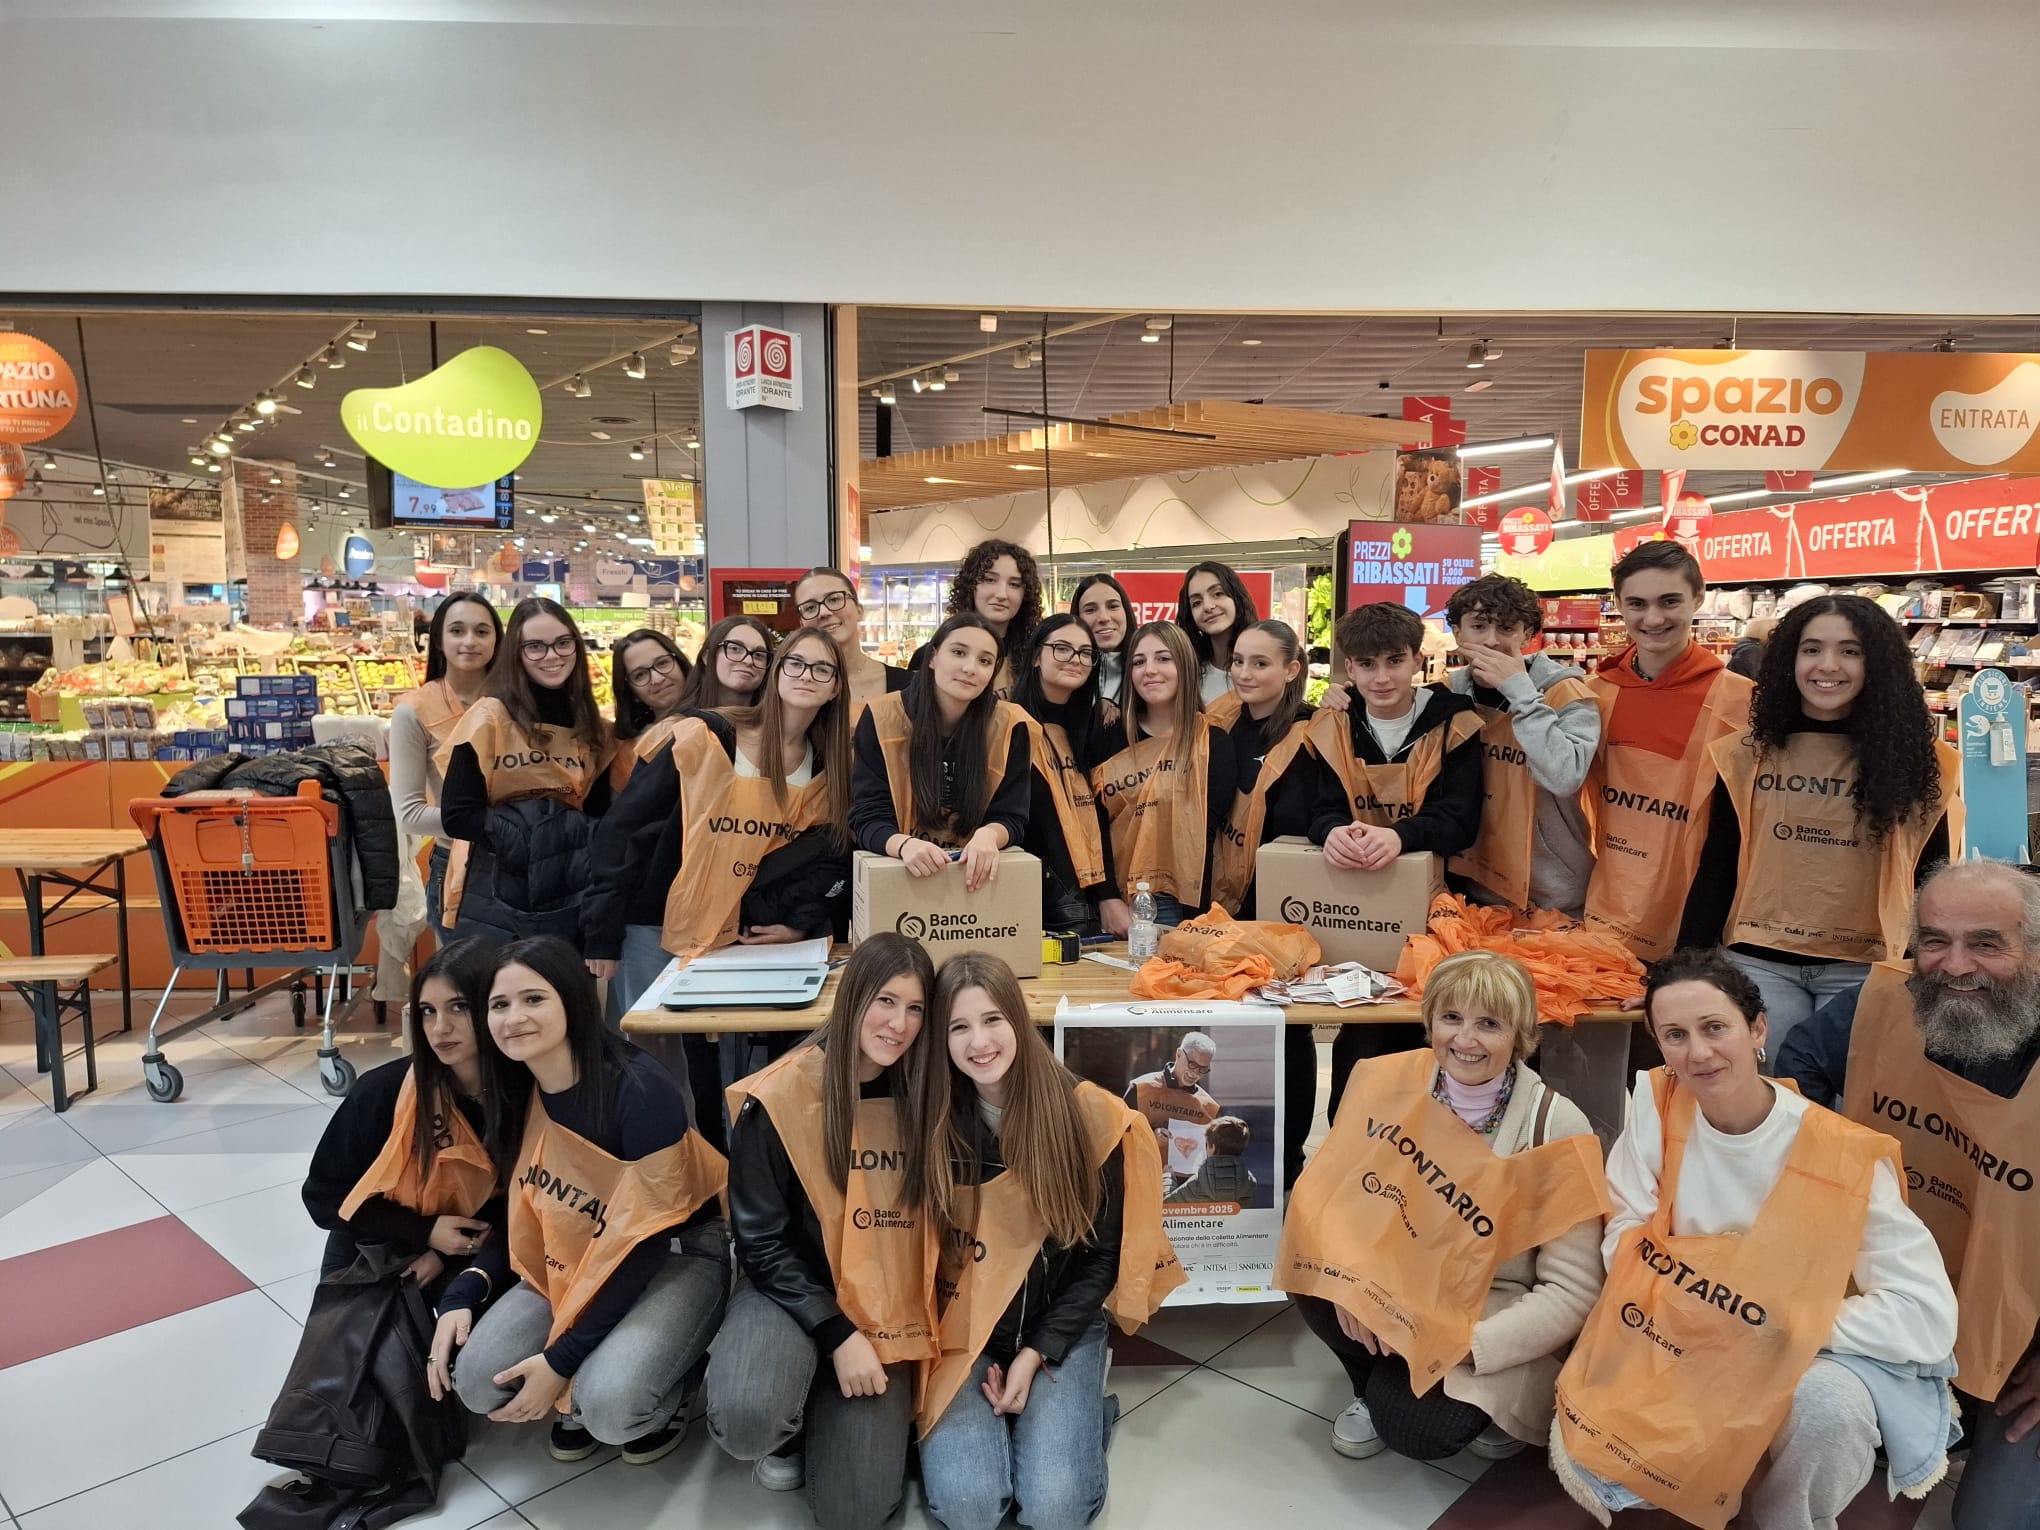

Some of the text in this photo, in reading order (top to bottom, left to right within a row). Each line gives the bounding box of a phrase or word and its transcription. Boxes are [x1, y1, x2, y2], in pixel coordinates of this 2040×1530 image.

[0, 362, 55, 380] AZIO
[762, 387, 792, 398] IDRANTE
[1635, 375, 1843, 423] spazio
[357, 402, 531, 441] il Contadino
[1941, 408, 2029, 429] ENTRATA
[1701, 425, 1805, 447] CONAD
[1503, 524, 1549, 533] RIBASSATI
[1809, 518, 1896, 551] OFFERTA
[1354, 541, 1390, 560] PREZZI
[1704, 532, 1771, 560] OFFERTA
[1454, 559, 1474, 568] OLTRE
[1353, 561, 1439, 585] RIBASSATI
[1796, 825, 1831, 836] Banco
[1795, 834, 1859, 848] Alimentare
[1313, 901, 1360, 916] Banco
[930, 913, 977, 926] Banco
[1311, 915, 1401, 933] Alimentare
[928, 925, 1018, 941] Alimentare
[1148, 1100, 1204, 1119] VOLONTARIO
[1872, 1090, 2034, 1192] VOLONTARIO
[1384, 1183, 1408, 1208] Banco
[1930, 1175, 1963, 1199] Banco
[1162, 1205, 1233, 1215] ovembre 2025
[1163, 1220, 1224, 1229] Alimentare
[1203, 1264, 1226, 1272] INTESA
[1605, 1441, 1631, 1464] INTESA
